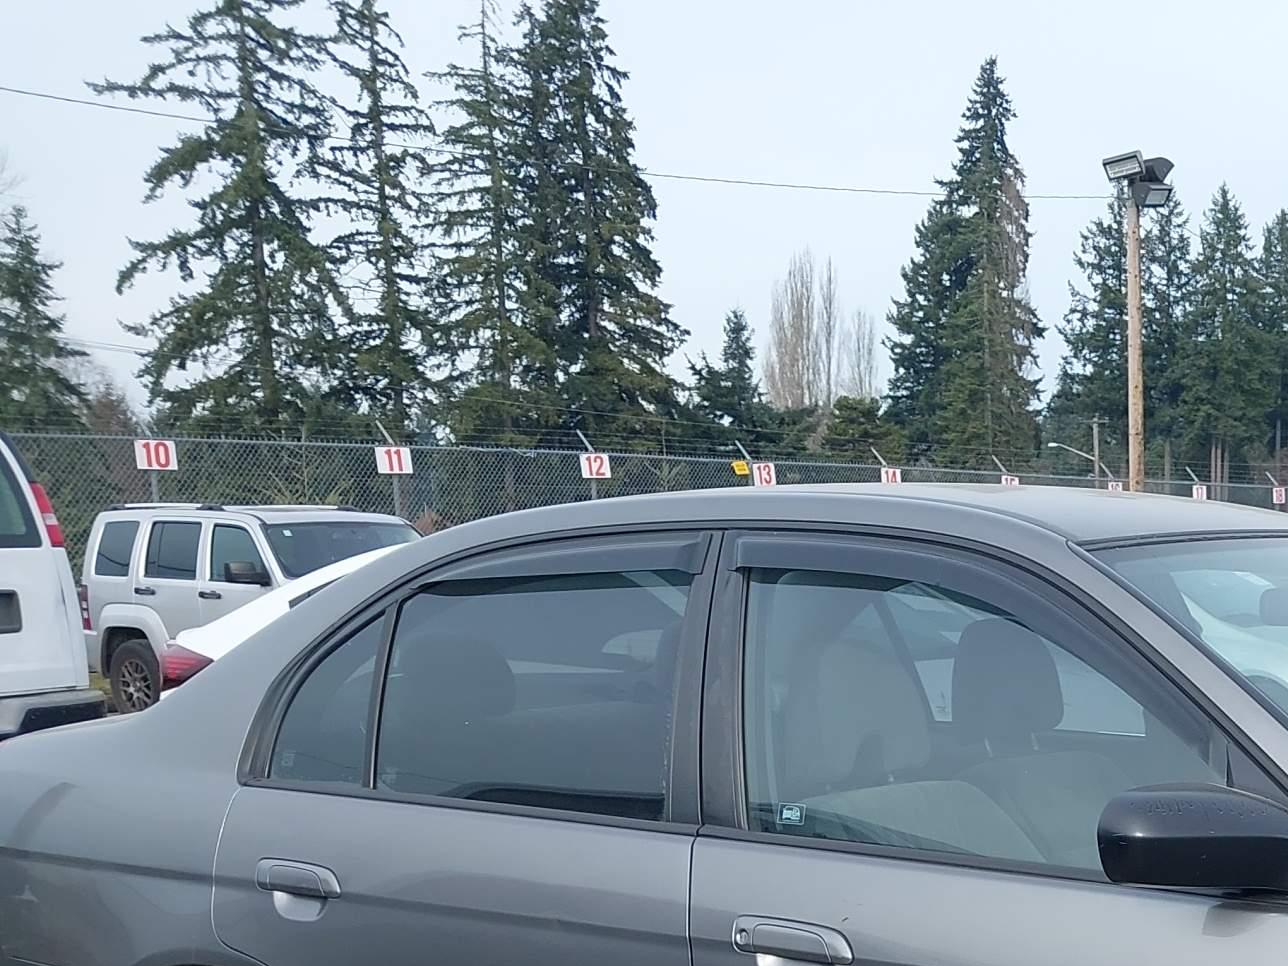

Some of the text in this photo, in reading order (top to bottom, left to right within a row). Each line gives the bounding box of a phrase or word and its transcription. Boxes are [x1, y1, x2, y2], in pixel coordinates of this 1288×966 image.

[142, 442, 170, 469] 10
[384, 448, 403, 471] 11
[585, 456, 606, 477] 12
[757, 464, 772, 485] 13
